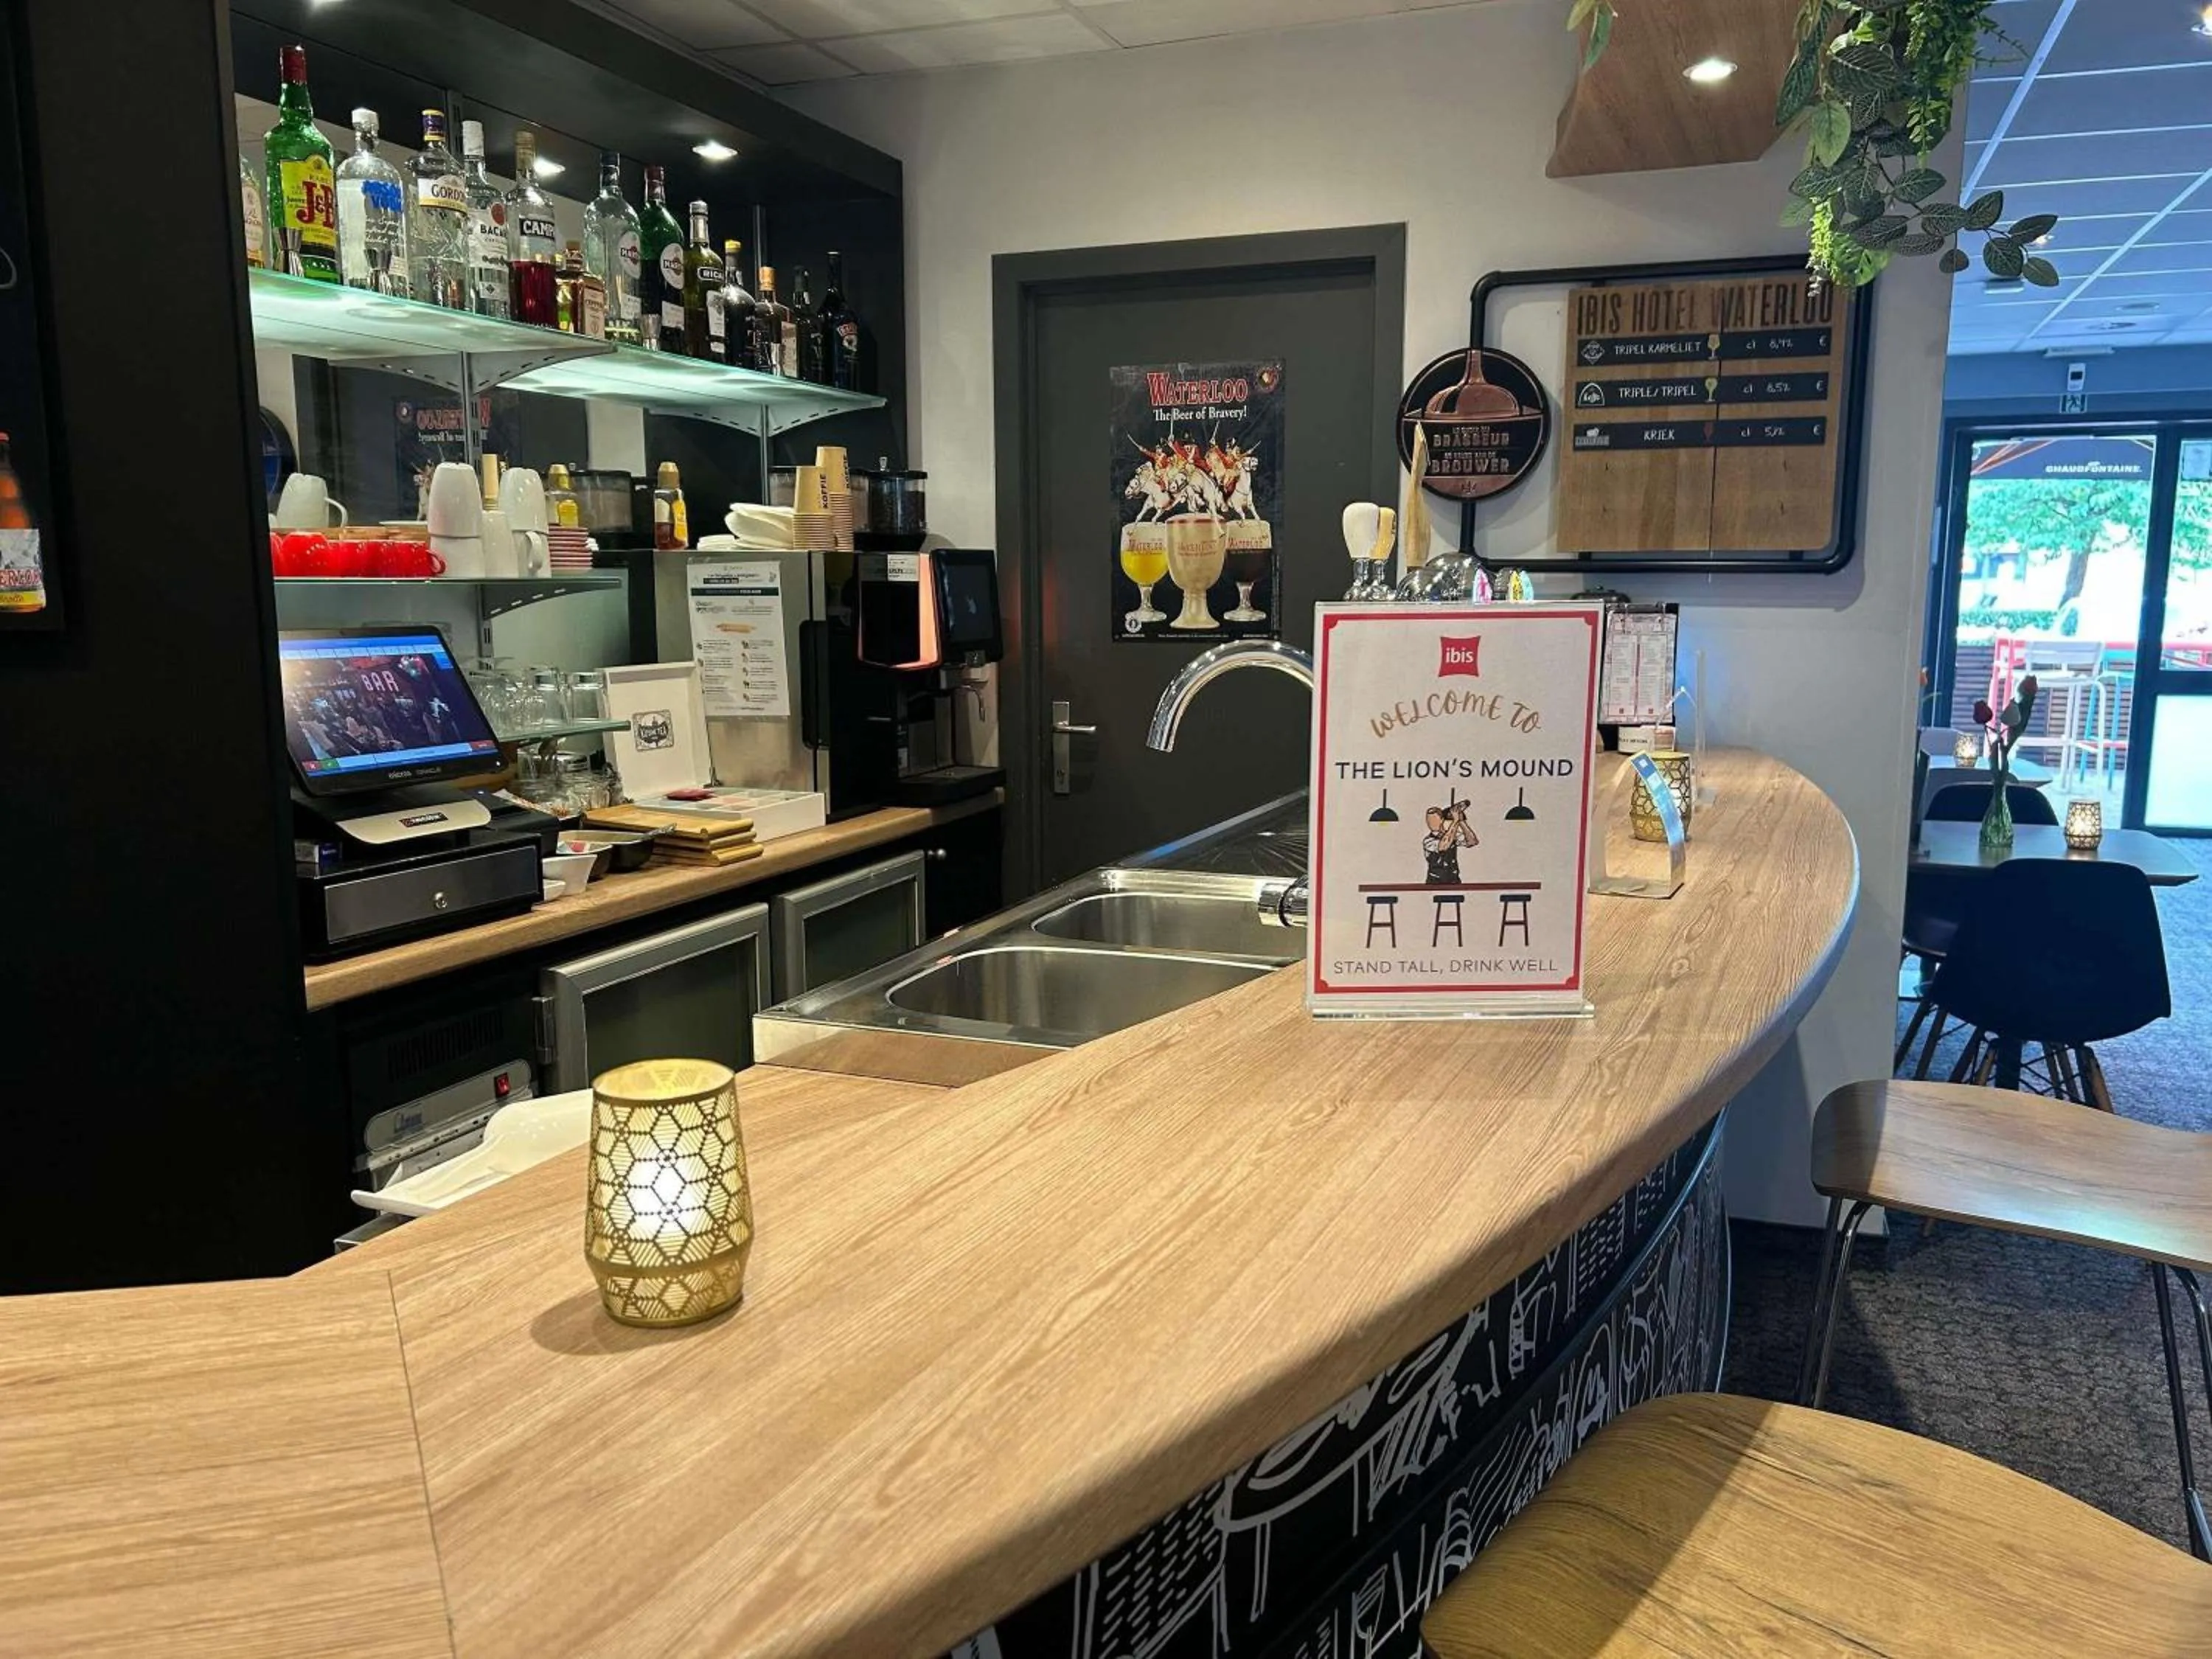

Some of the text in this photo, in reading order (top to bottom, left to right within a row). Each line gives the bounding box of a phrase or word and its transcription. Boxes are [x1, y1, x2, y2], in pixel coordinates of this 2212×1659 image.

[1577, 293, 1621, 335] IBIS
[1632, 288, 1698, 332] HOTEL
[1614, 344, 1646, 355] TRIPEL
[1648, 341, 1701, 353] KARMELIET
[1147, 372, 1248, 406] WATERLOO
[1661, 385, 1697, 397] TRIPEL
[1153, 405, 1248, 422] The Beer of Bravery!
[1433, 433, 1510, 448] BRASSEUR
[1644, 428, 1675, 440] KRIEK
[1431, 458, 1510, 473] BROUWER
[1445, 647, 1474, 663] ibis
[361, 669, 400, 692] BAR
[1370, 689, 1542, 738] WELCOME TO
[1335, 758, 1573, 779] THE LION'S MOUND
[1333, 959, 1559, 975] STAND TALL, DRINK WELL
